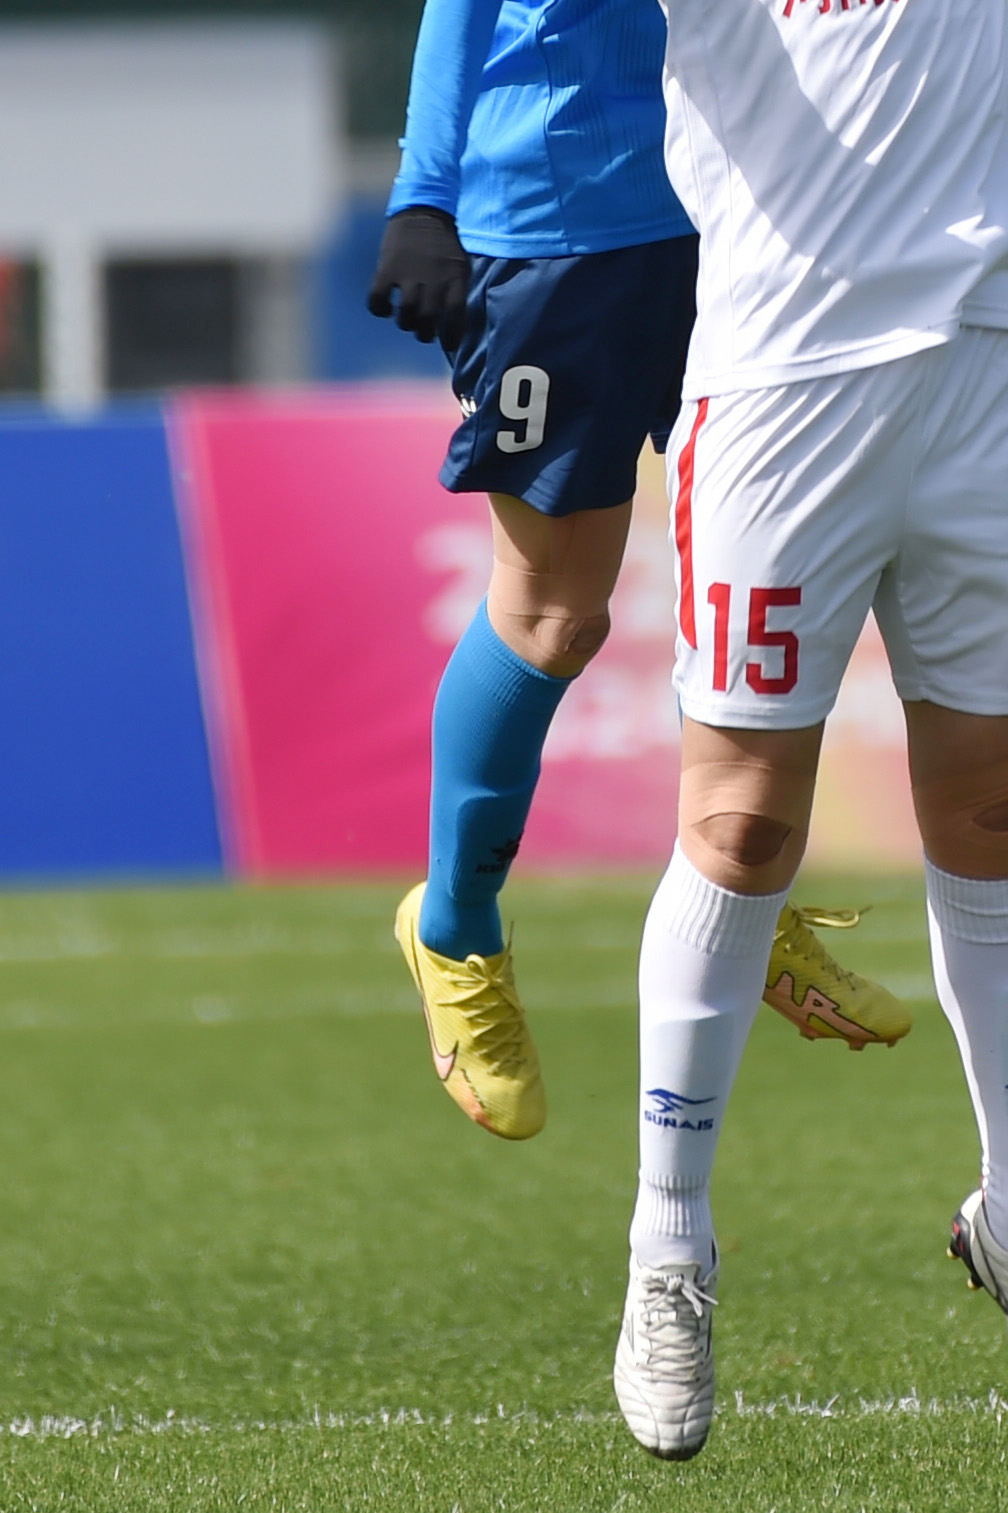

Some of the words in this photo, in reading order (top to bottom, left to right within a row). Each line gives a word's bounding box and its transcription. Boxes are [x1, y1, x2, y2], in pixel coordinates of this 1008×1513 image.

[496, 365, 550, 454] 9
[707, 582, 802, 695] 15
[644, 1109, 715, 1132] SUNAIS
